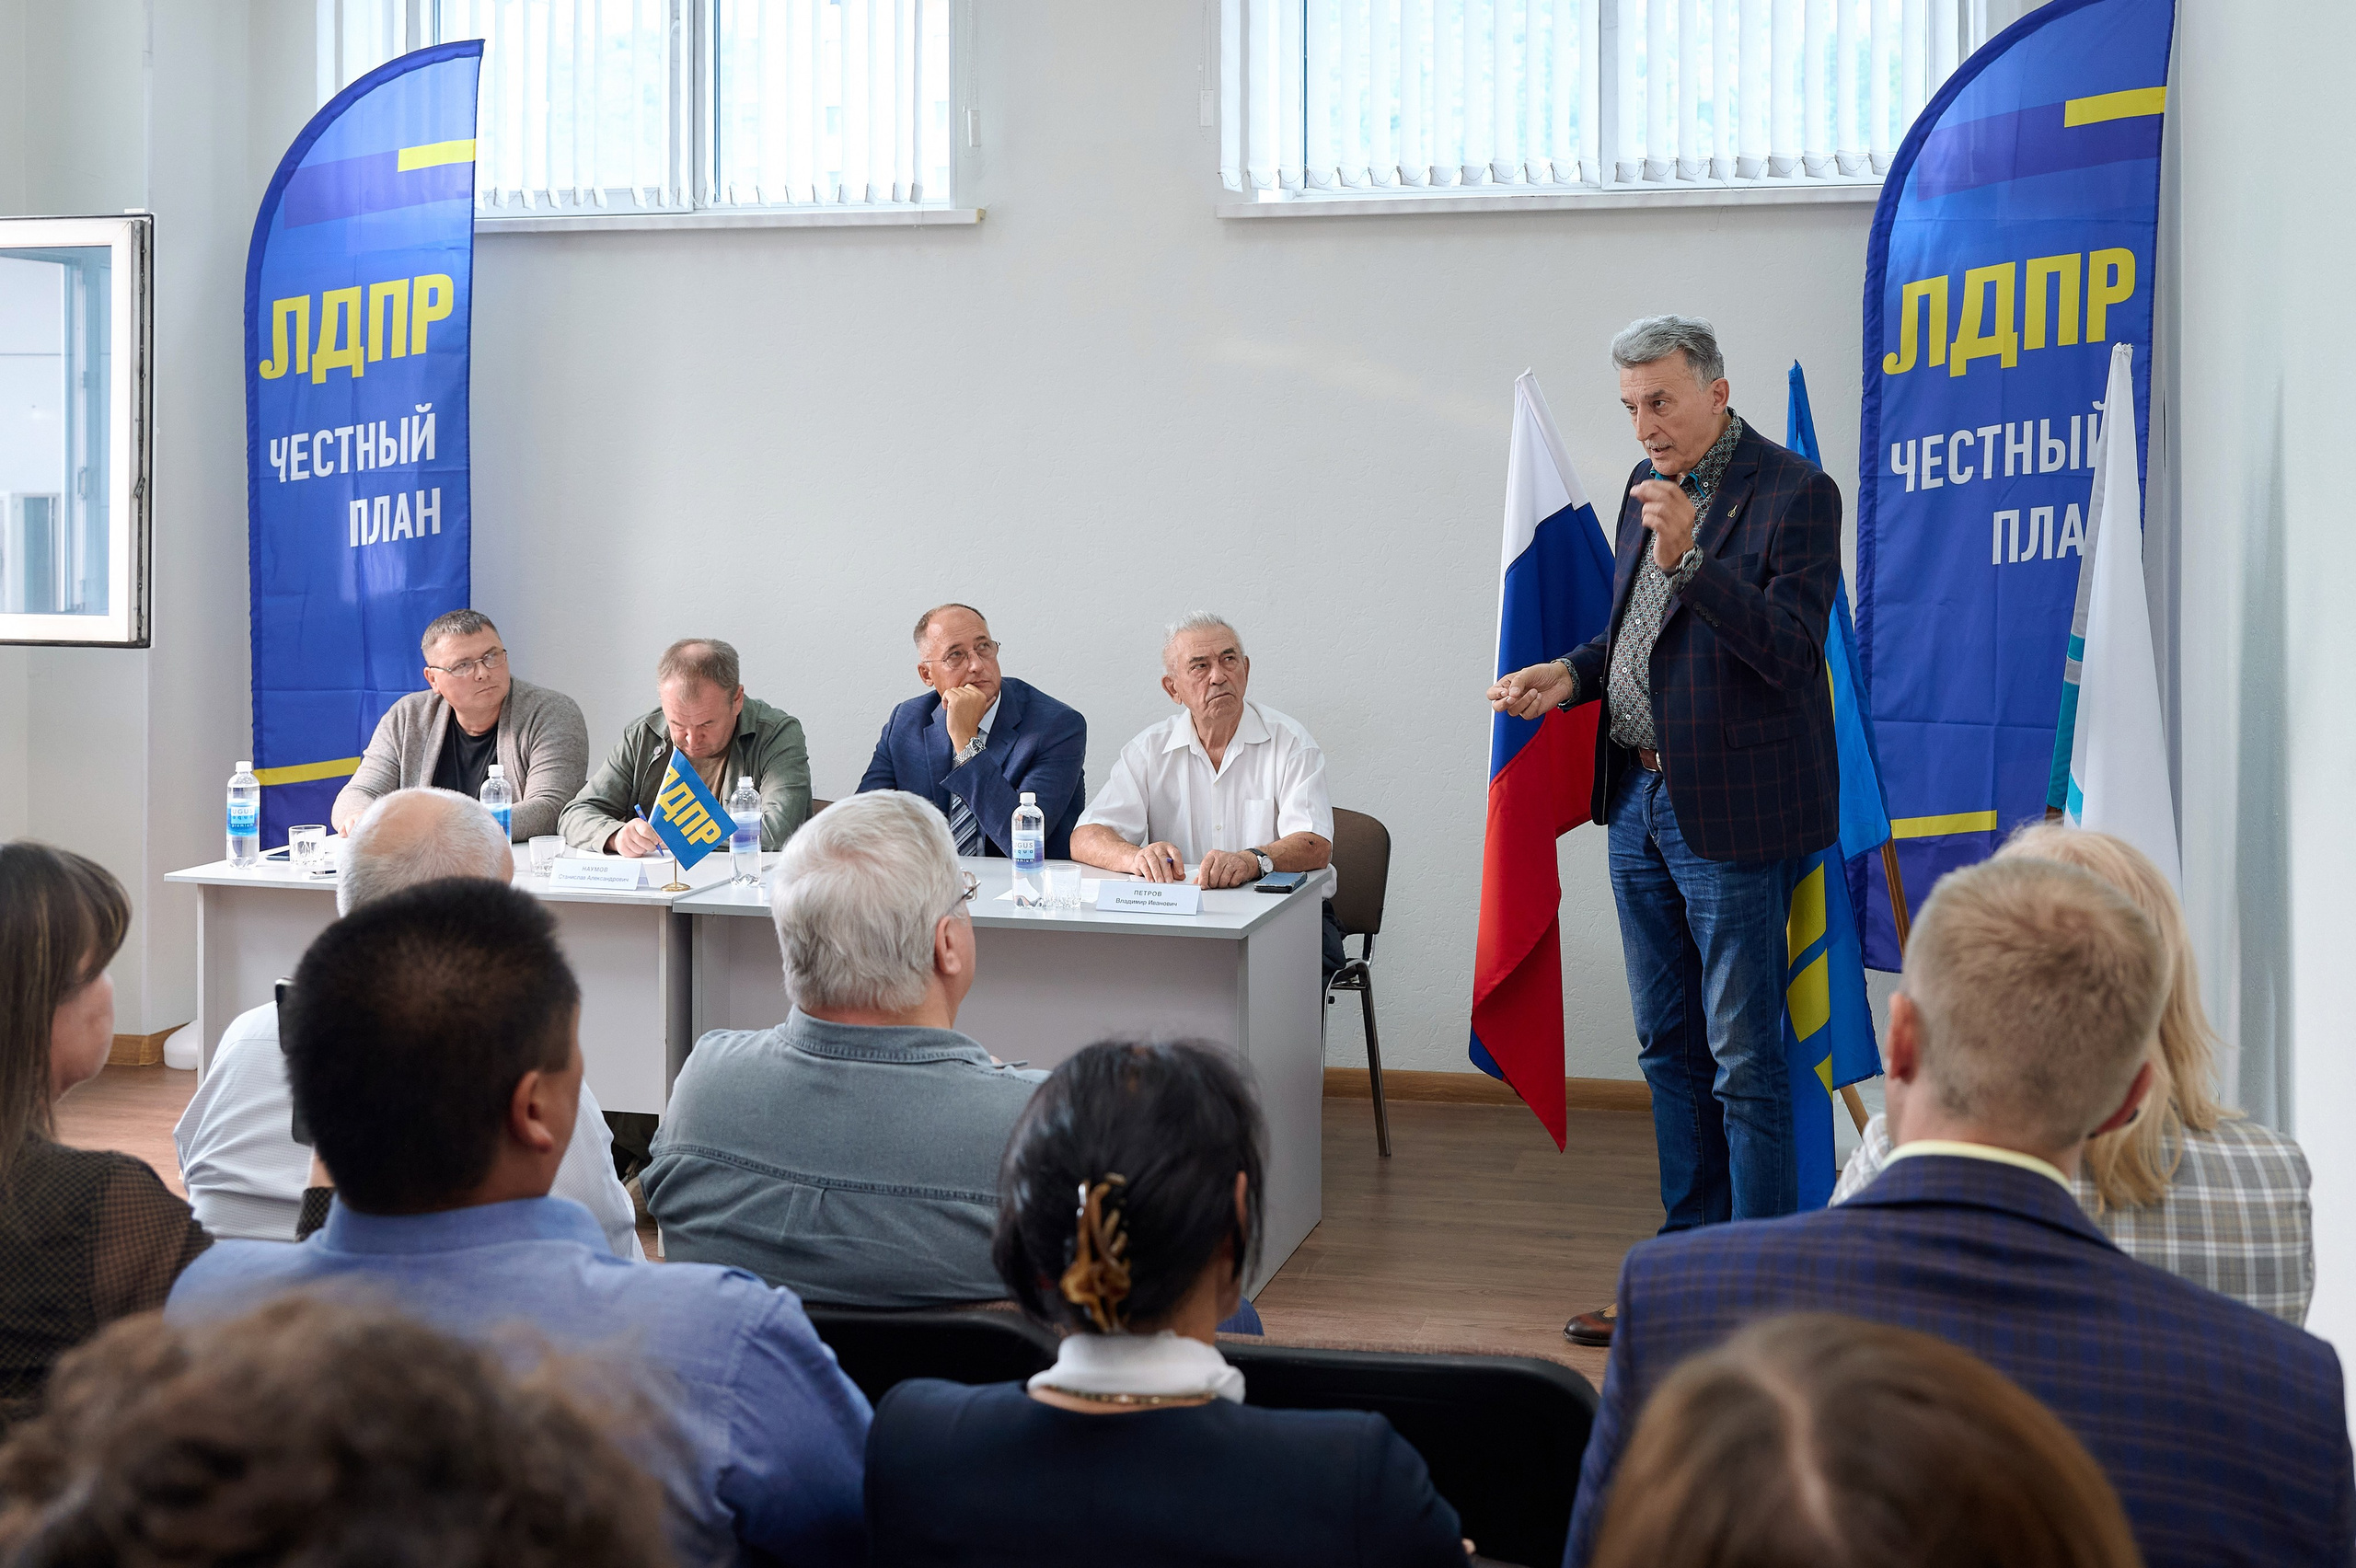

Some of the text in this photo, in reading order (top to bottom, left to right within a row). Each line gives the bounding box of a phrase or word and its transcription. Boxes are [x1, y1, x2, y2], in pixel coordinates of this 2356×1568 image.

[259, 273, 455, 385] ЛДПР
[1882, 247, 2136, 378] ЛДПР
[270, 402, 436, 483] ЧЕСТНЫЙ
[349, 487, 442, 548] ПЛАН
[1992, 502, 2085, 565] ПЛА
[1115, 897, 1178, 907] Владимир Иванович
